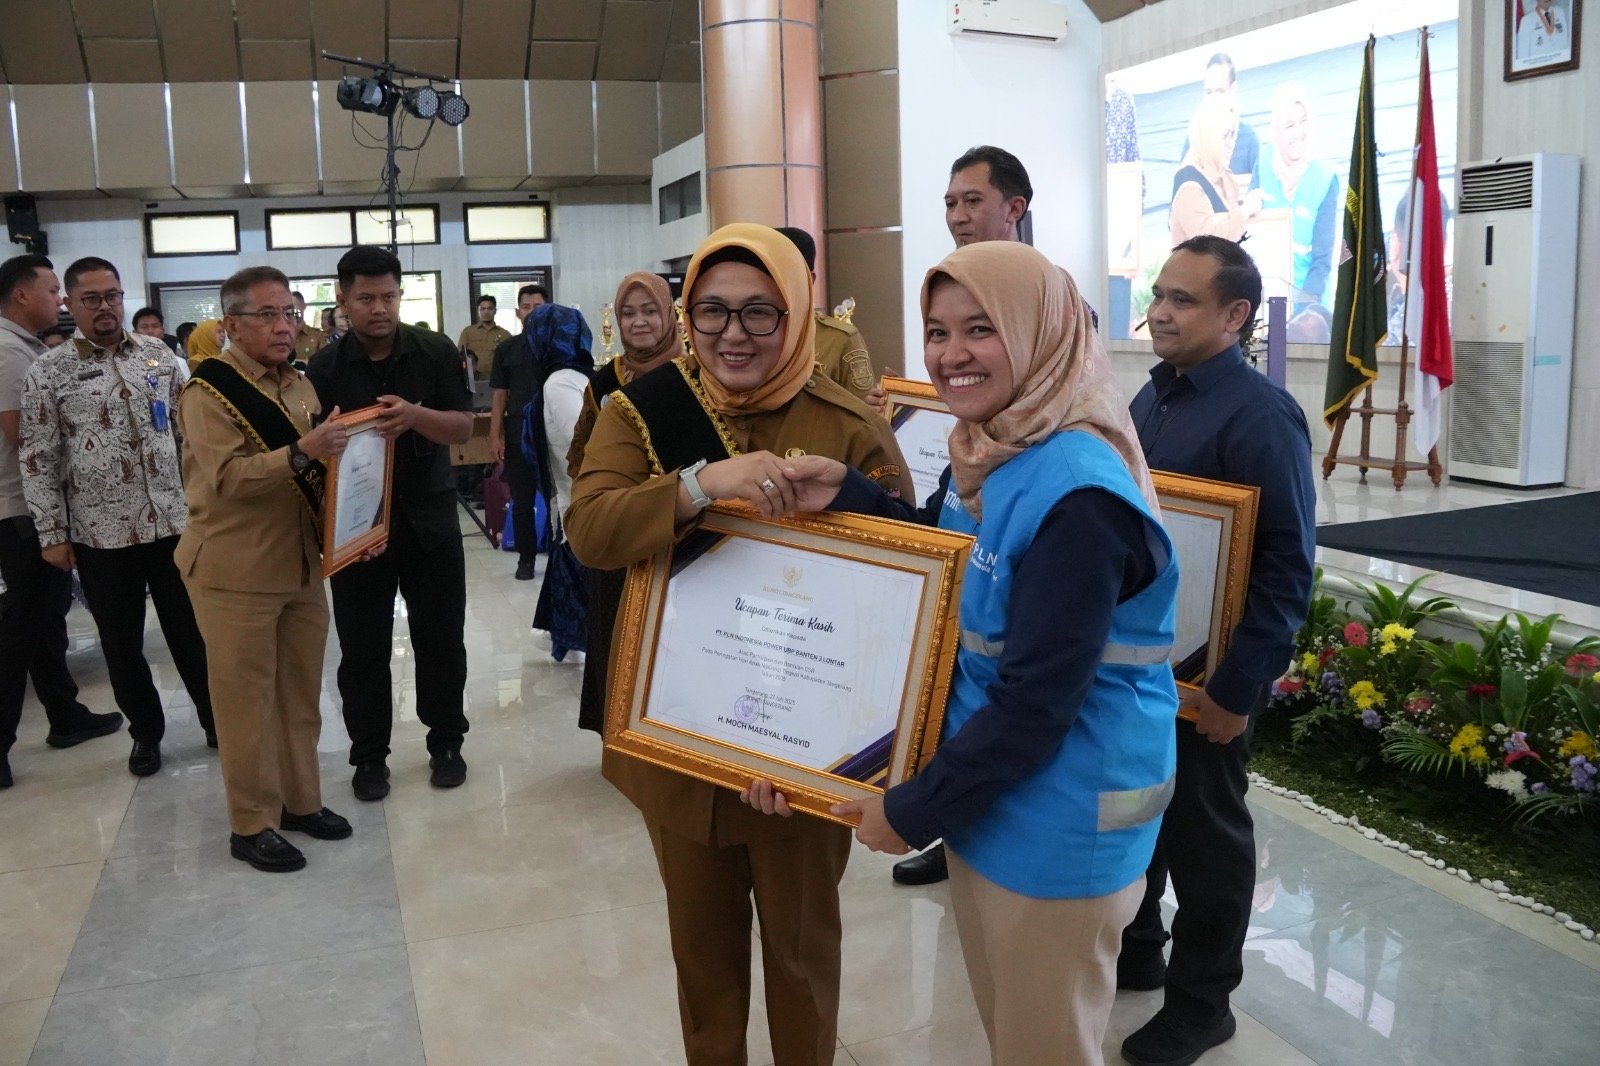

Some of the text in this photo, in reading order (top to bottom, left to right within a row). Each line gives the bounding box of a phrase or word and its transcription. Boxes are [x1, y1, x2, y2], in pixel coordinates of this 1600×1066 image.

[973, 542, 998, 566] PLN
[735, 597, 836, 634] Ucapan Terima Kasih
[724, 631, 734, 639] PLN
[734, 634, 762, 646] INDONESIA
[764, 642, 782, 651] POWER
[784, 646, 795, 655] UBP
[796, 650, 818, 660] BANTEN
[823, 657, 845, 667] LONTAR
[787, 632, 806, 642] Kepada
[717, 715, 810, 748] H. MOCH MAESYAL RASYID
